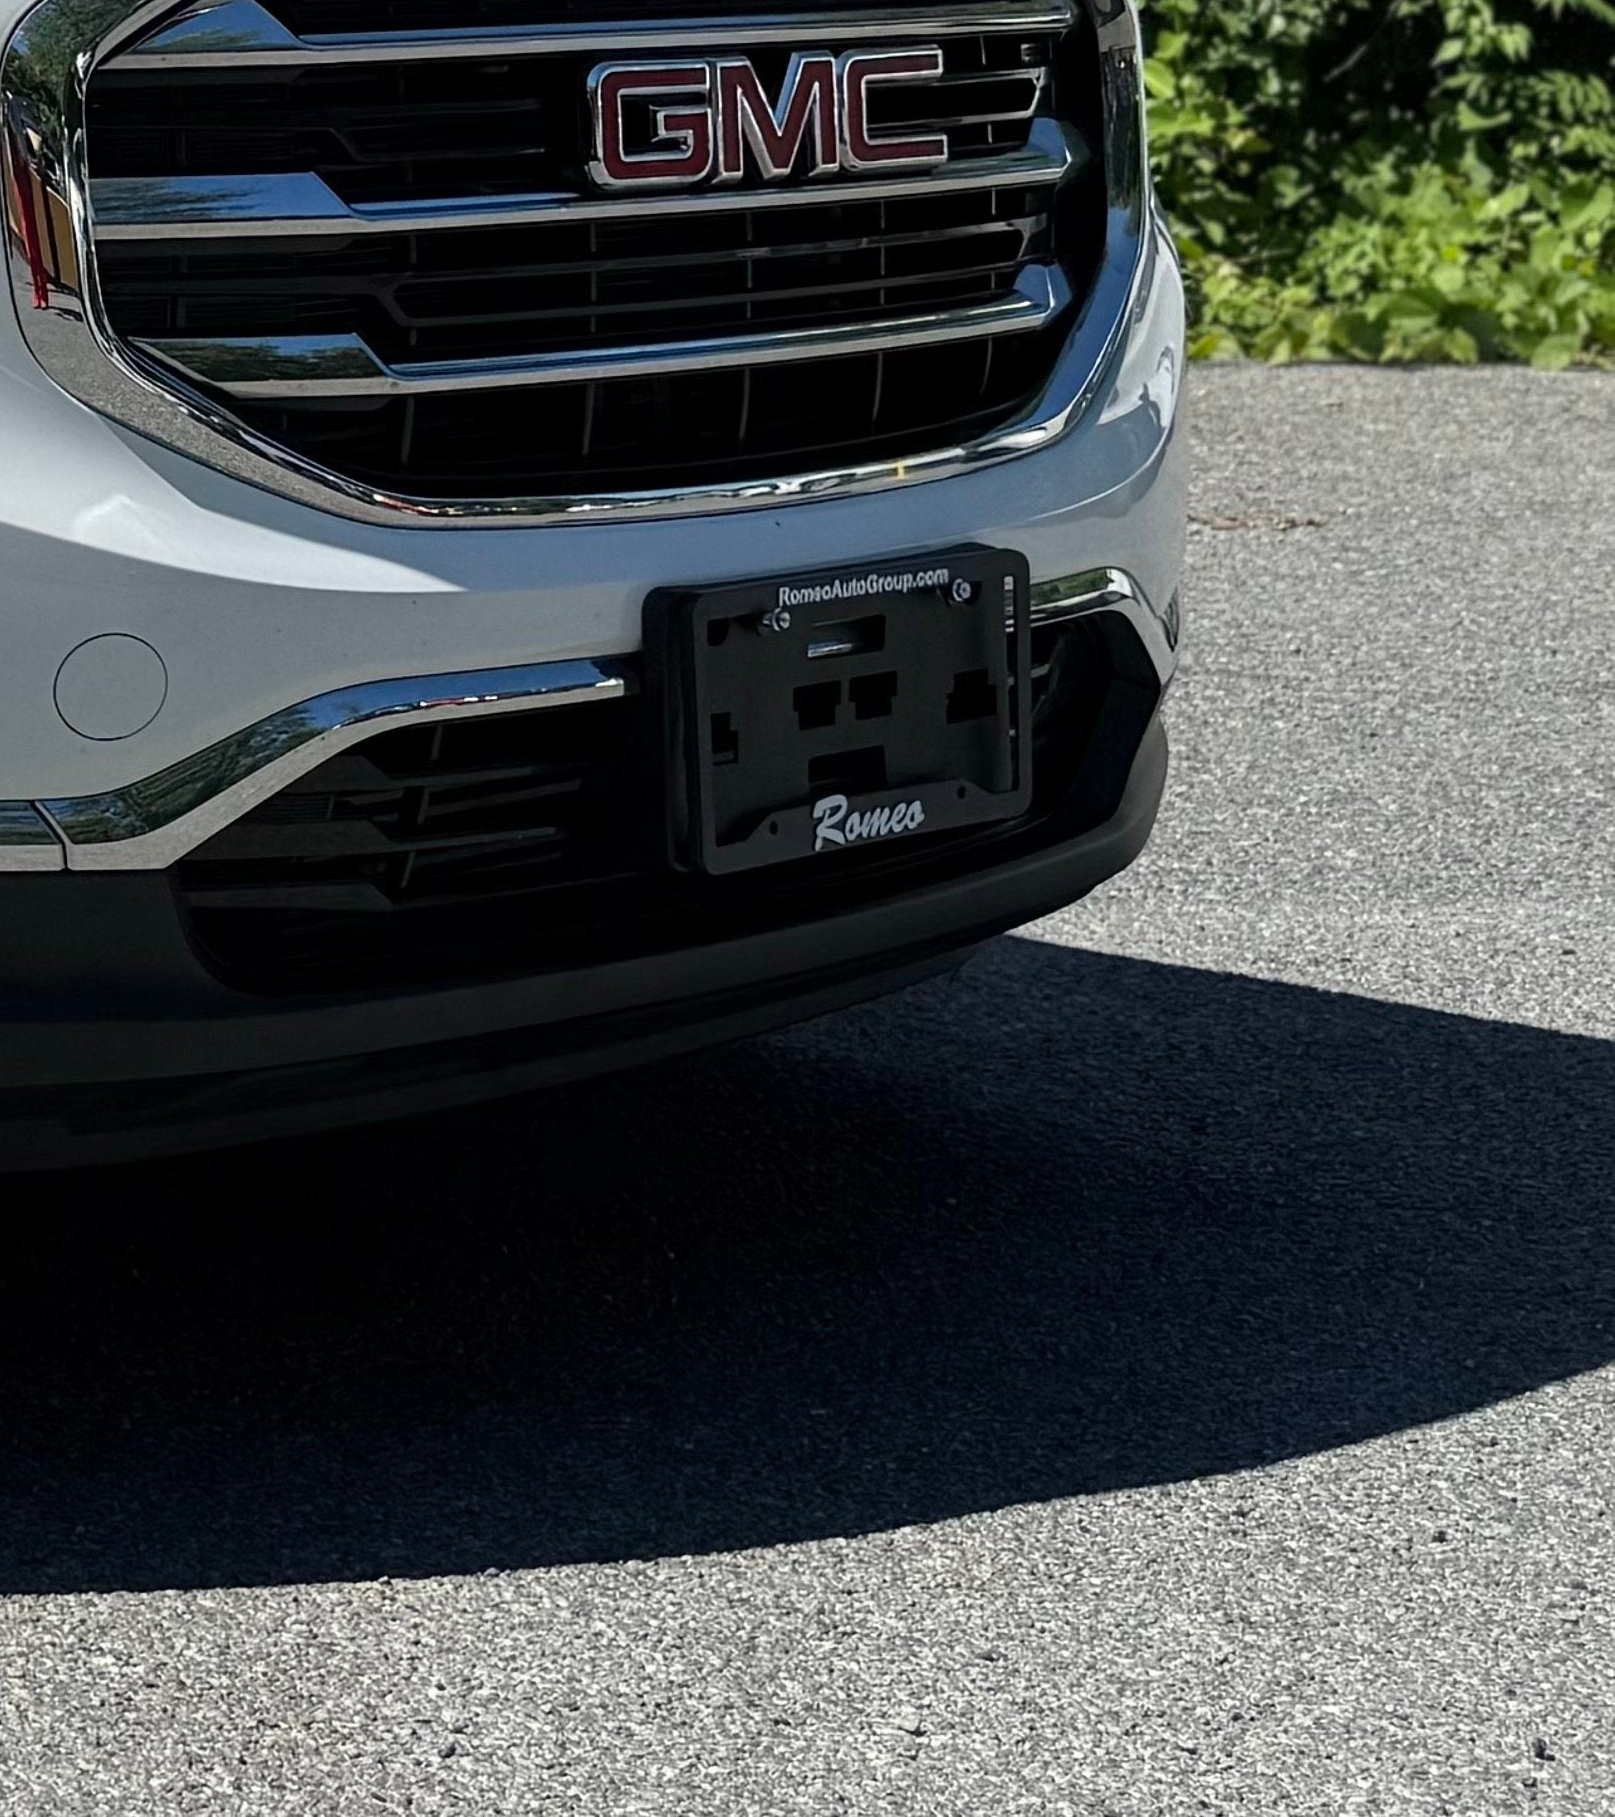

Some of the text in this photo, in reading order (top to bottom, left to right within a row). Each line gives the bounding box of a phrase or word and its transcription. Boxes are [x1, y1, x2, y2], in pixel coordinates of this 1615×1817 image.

[586, 44, 949, 190] GMC
[777, 567, 949, 607] RomeoAutoGroup.com
[811, 793, 926, 852] Romeo
